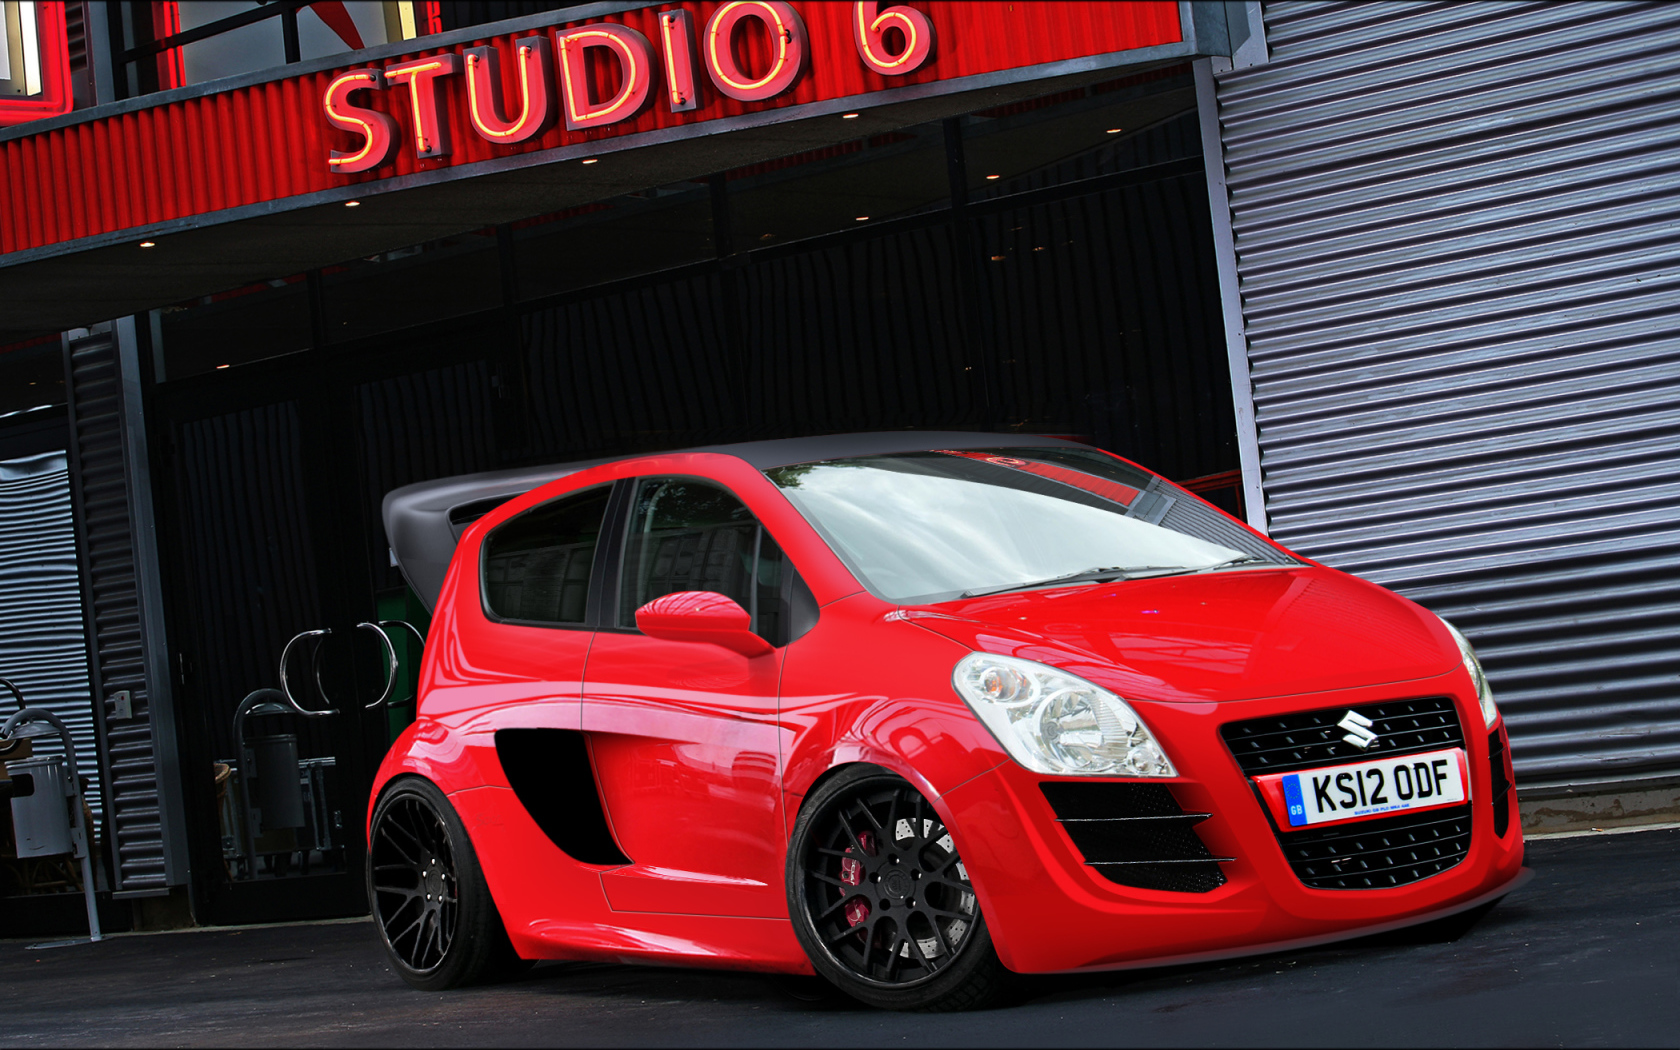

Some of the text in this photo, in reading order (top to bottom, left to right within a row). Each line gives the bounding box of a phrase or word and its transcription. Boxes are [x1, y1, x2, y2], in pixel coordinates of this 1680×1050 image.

[323, 0, 931, 173] STUDIO 6
[1290, 804, 1303, 816] GB
[1312, 759, 1448, 813] KS12 ODF
